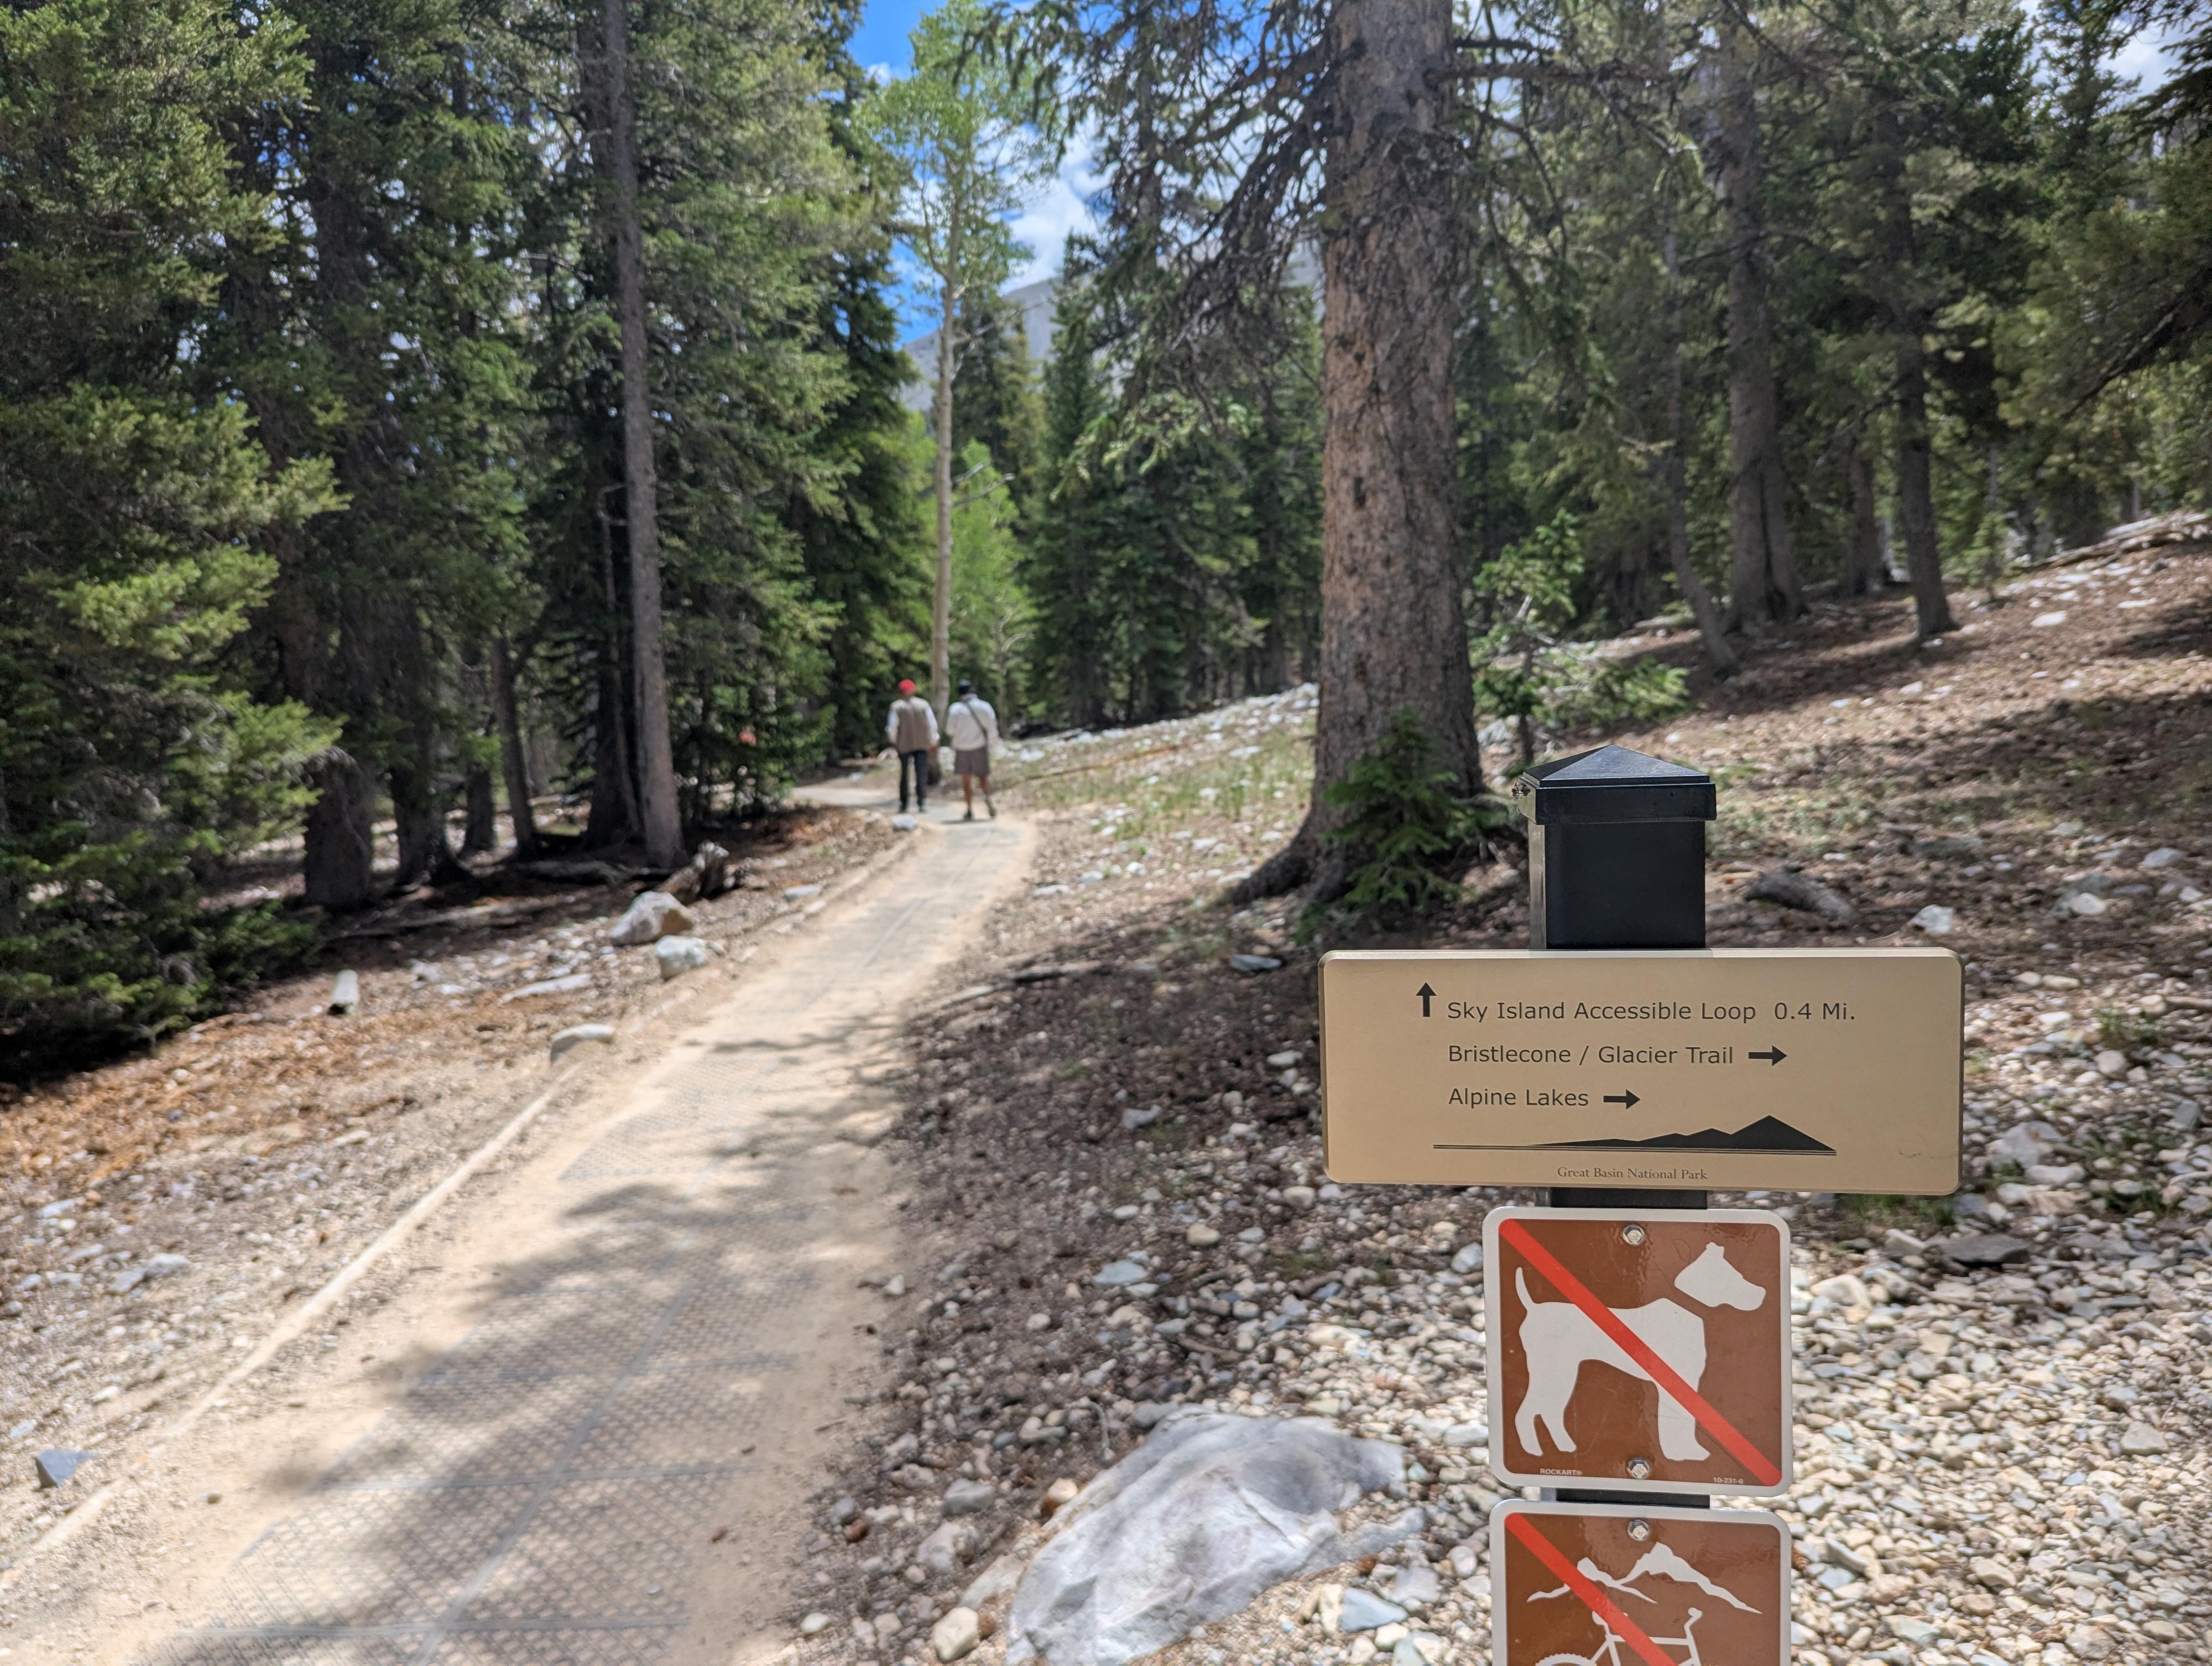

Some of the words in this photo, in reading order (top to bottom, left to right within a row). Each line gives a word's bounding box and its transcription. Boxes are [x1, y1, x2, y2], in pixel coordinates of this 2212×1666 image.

[1448, 1001, 1488, 1023] Sky
[1497, 1001, 1564, 1019] Island
[1573, 1002, 1692, 1020] Accessible
[1702, 1002, 1756, 1024] Loop
[1774, 1002, 1812, 1020] 0.4
[1823, 1002, 1855, 1020] Mi.
[1449, 1044, 1571, 1063] Bristlecone
[1578, 1045, 1590, 1066] /
[1598, 1045, 1678, 1064] Glacier
[1685, 1046, 1733, 1064] Trail
[1448, 1087, 1517, 1109] Alpine
[1526, 1088, 1589, 1106] Lakes
[1557, 1167, 1590, 1178] Great
[1593, 1167, 1624, 1178] Basin
[1627, 1168, 1677, 1179] National
[1681, 1169, 1708, 1180] Park
